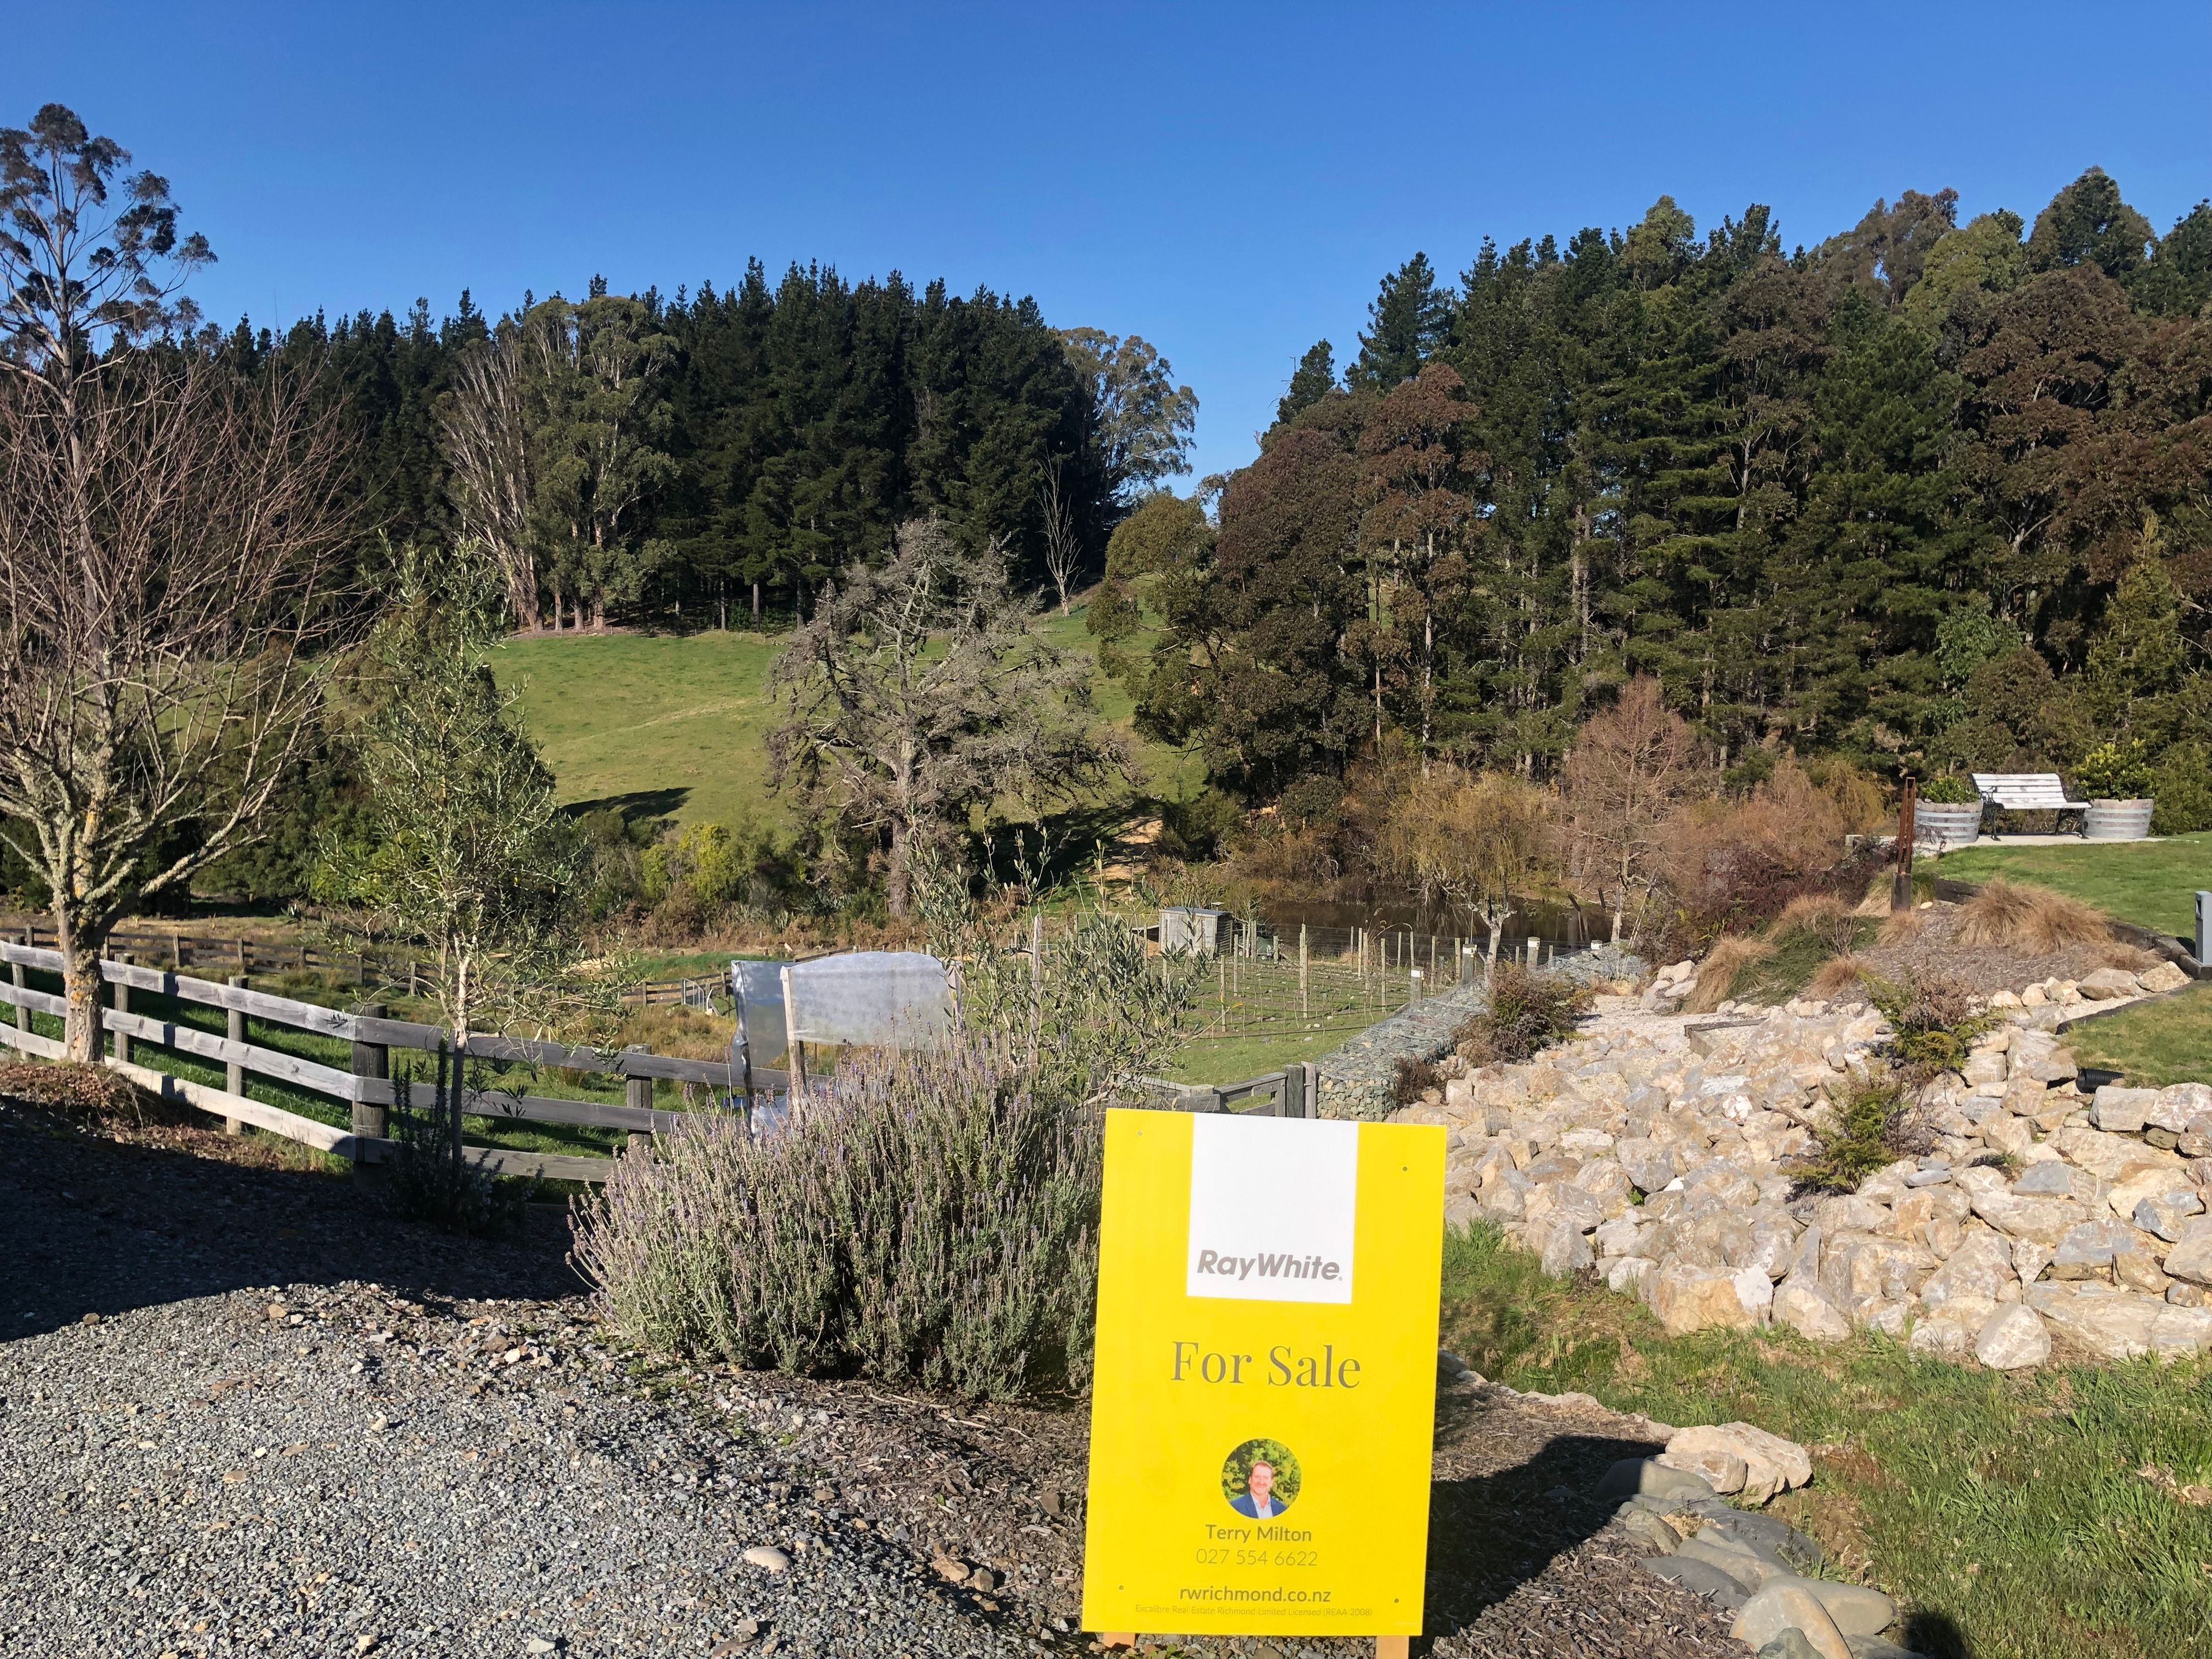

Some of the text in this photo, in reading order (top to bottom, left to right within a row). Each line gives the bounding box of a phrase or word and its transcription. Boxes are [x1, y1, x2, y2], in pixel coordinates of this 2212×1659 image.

[1171, 1341, 1361, 1388] For Sale
[1205, 1524, 1312, 1543] Terry Milton
[1196, 1548, 1318, 1566] 027 554 6622
[1180, 1585, 1332, 1603] rwrichmond.co.nz
[1135, 1604, 1373, 1617] Excalibre Real Estate Richmond Limited Licensed (REAA 2008)
